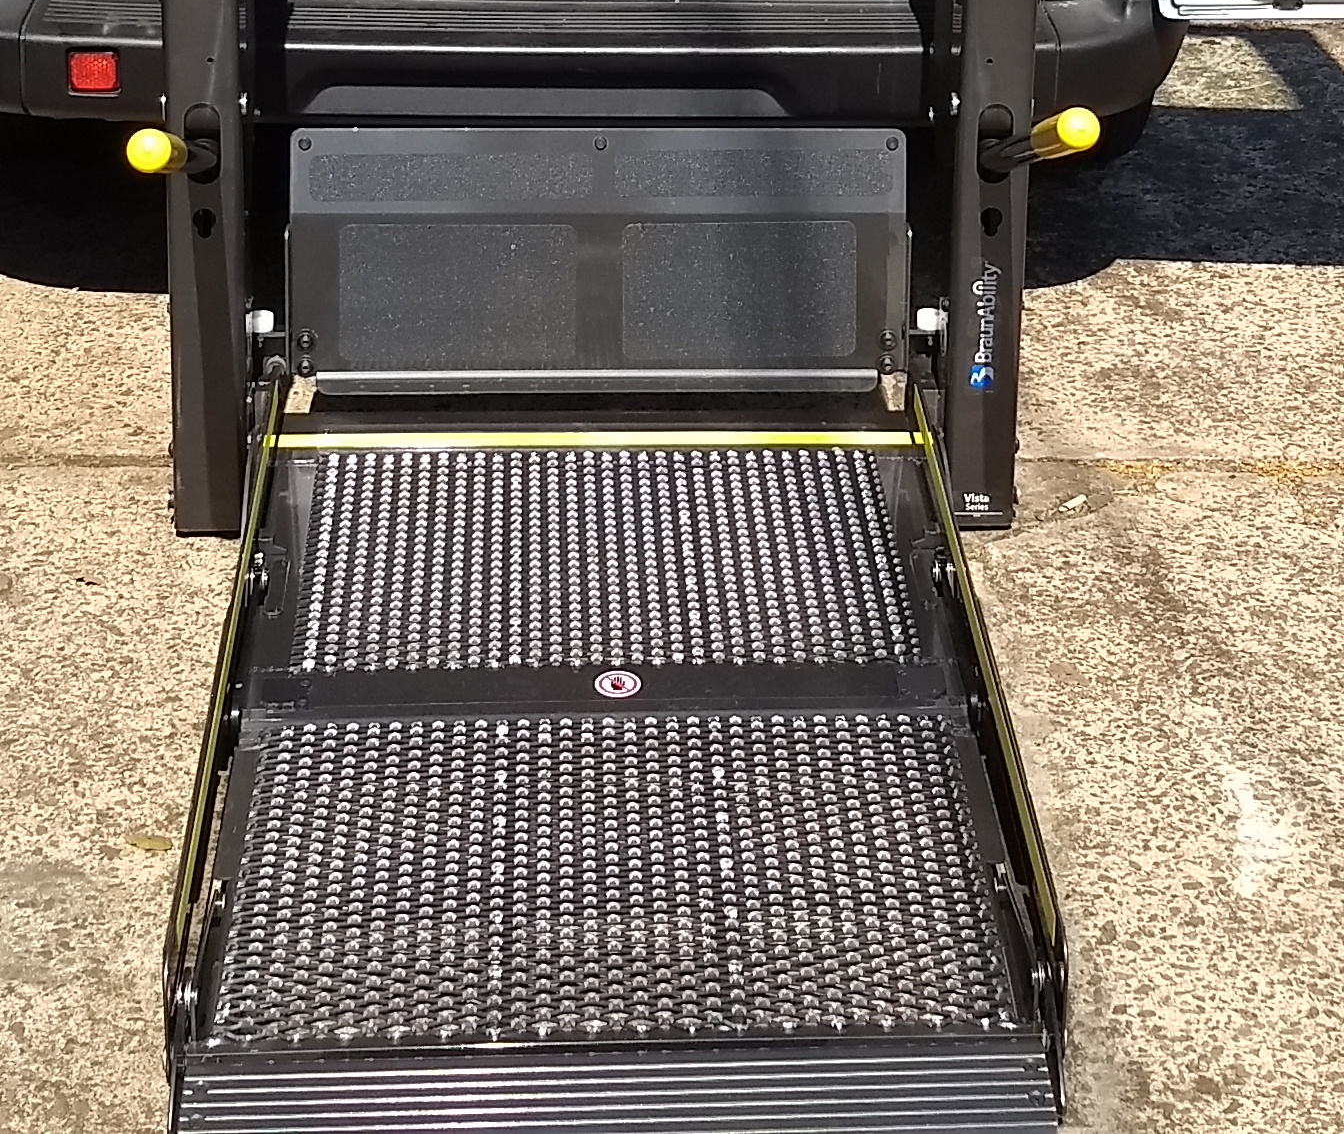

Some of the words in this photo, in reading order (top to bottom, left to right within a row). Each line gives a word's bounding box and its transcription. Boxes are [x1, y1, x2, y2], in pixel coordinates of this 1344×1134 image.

[971, 263, 1003, 363] BraunAbility
[963, 492, 991, 503] Vista
[965, 503, 989, 511] Series
